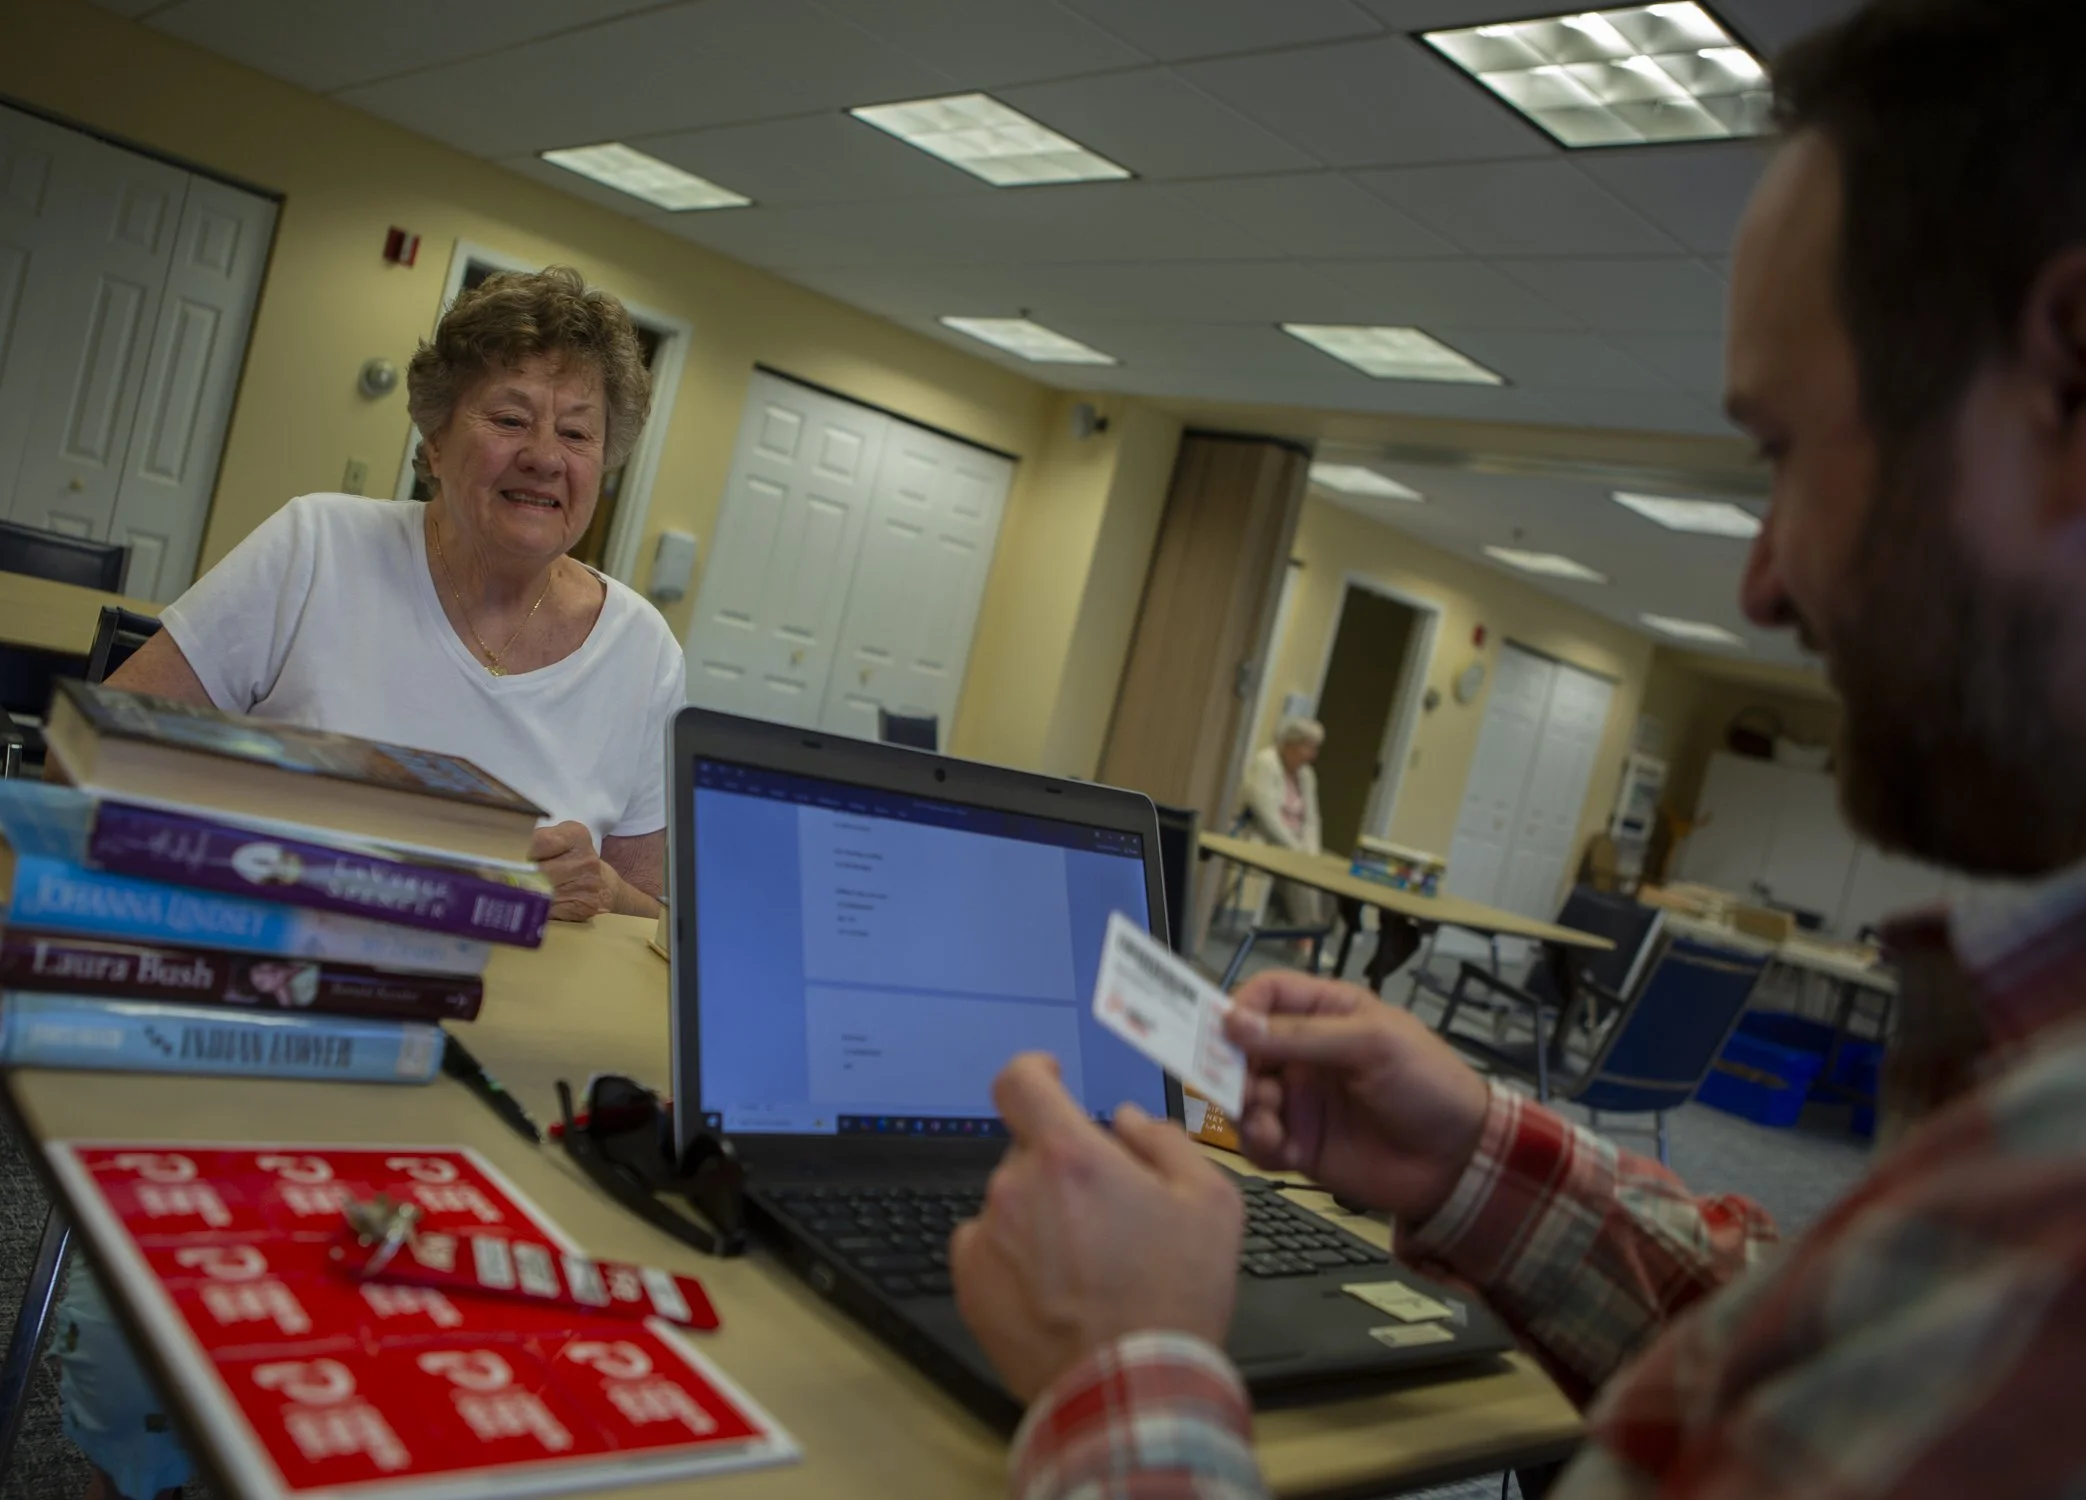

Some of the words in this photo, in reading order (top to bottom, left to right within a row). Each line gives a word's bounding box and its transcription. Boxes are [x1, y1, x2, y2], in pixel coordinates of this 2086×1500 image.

[32, 941, 130, 982] Laura
[136, 953, 215, 990] Bush
[1206, 1113, 1224, 1124] NEY
[1205, 1122, 1223, 1132] LAN
